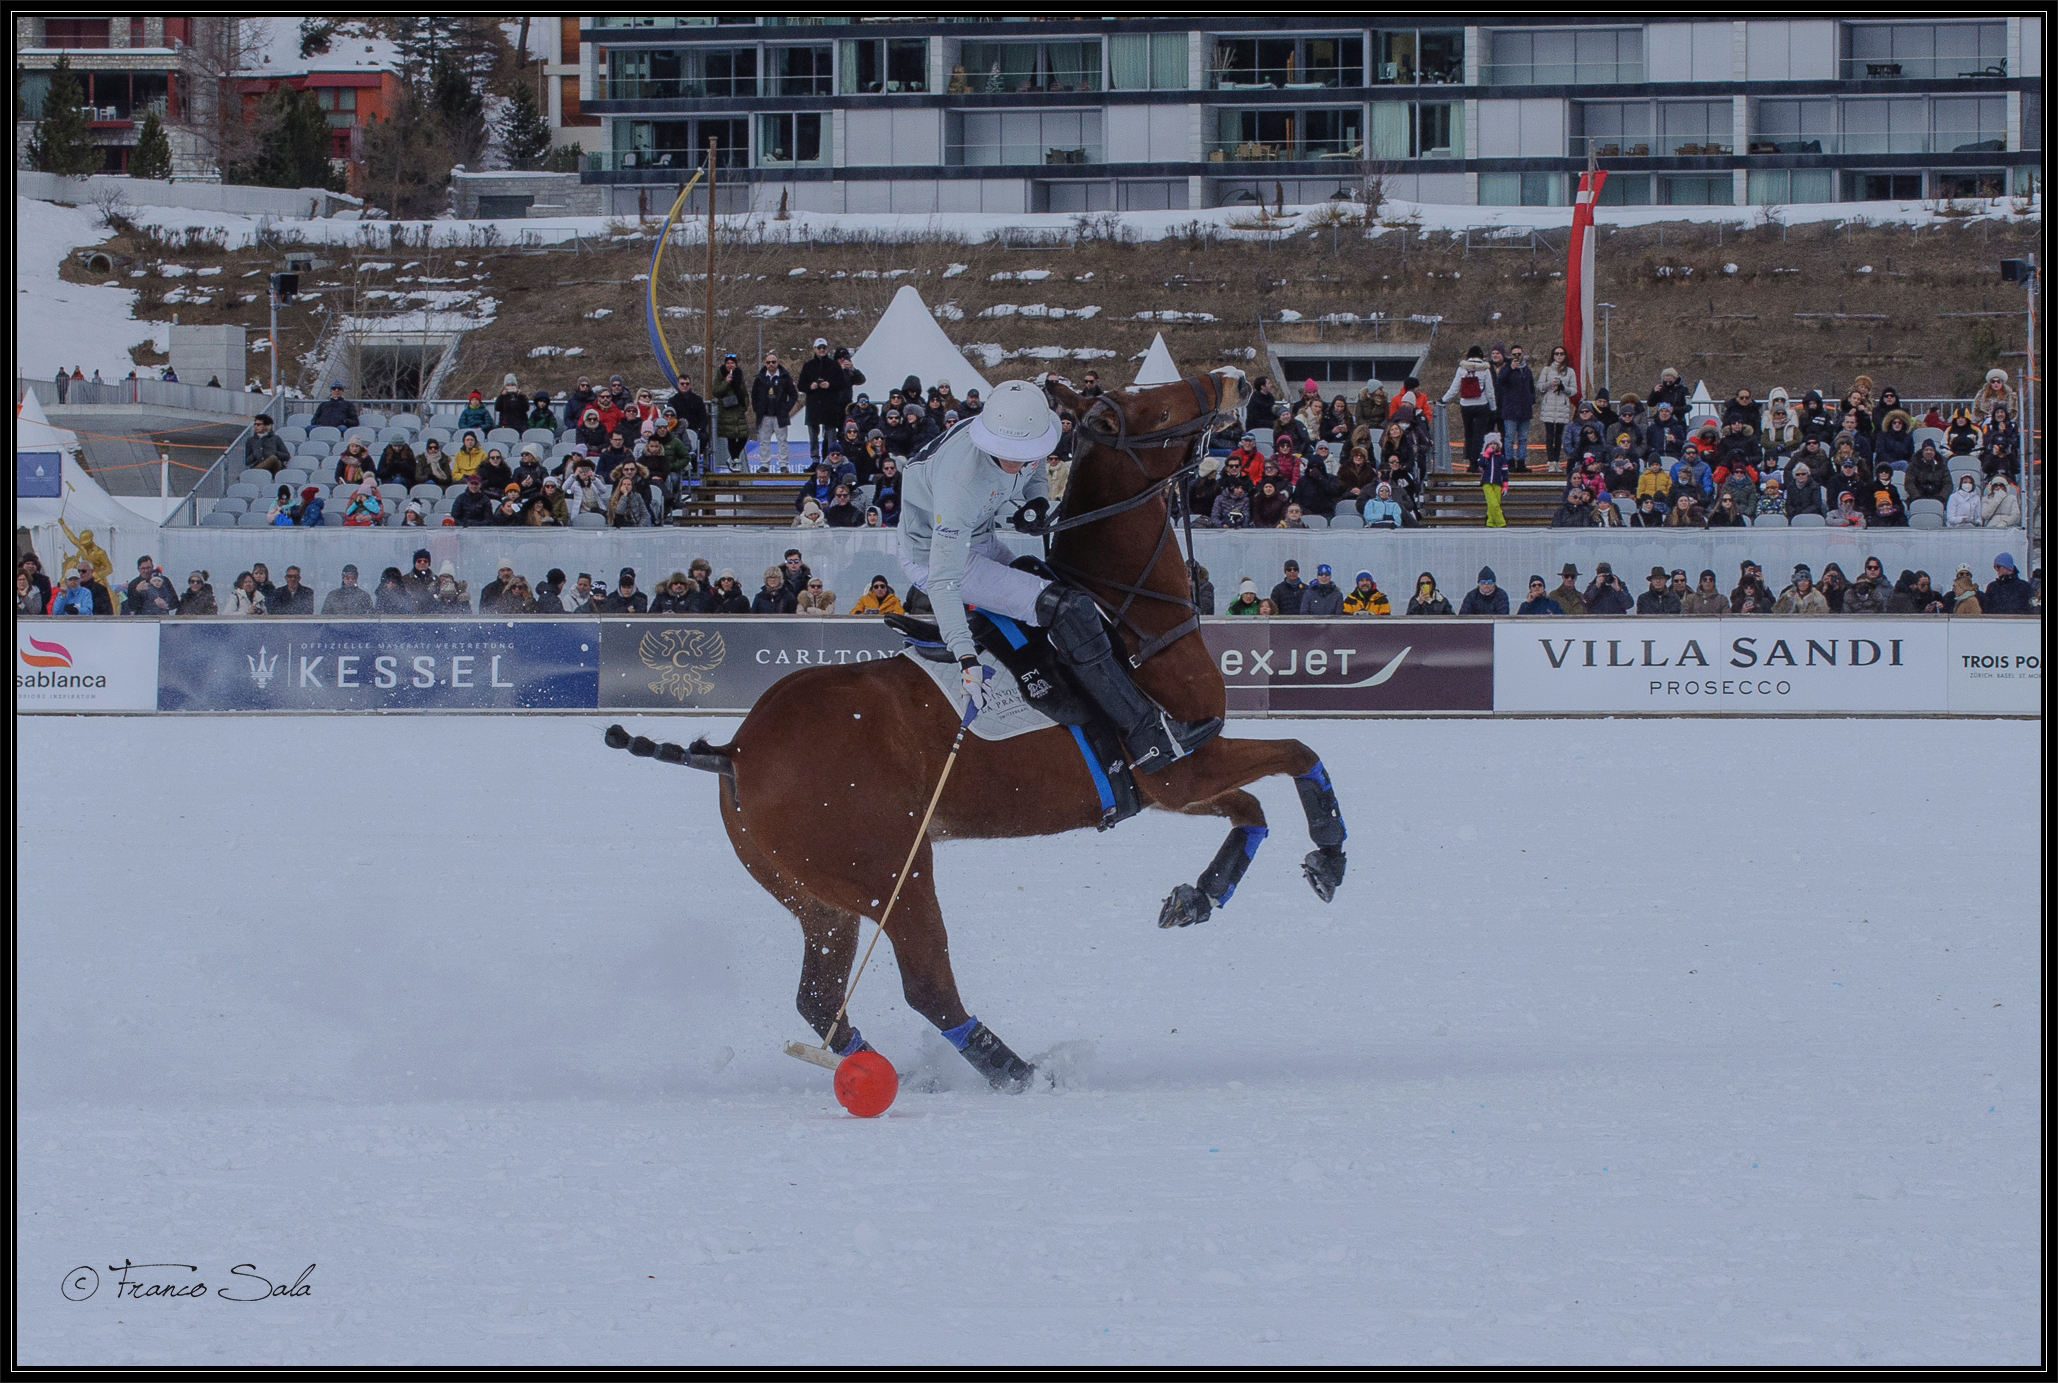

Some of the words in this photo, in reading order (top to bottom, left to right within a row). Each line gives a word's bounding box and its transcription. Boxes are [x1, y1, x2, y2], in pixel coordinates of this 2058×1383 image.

[301, 642, 370, 650] OFFIZIELLE
[1538, 638, 1710, 668] VILLA
[1729, 637, 1904, 668] SANDI
[755, 649, 903, 664] CARLTON
[1961, 655, 2009, 668] TROIS
[2015, 655, 2041, 669] PO
[299, 655, 514, 688] KESSEL
[17, 671, 106, 688] sablanca
[1650, 680, 1791, 695] PROSECCO
